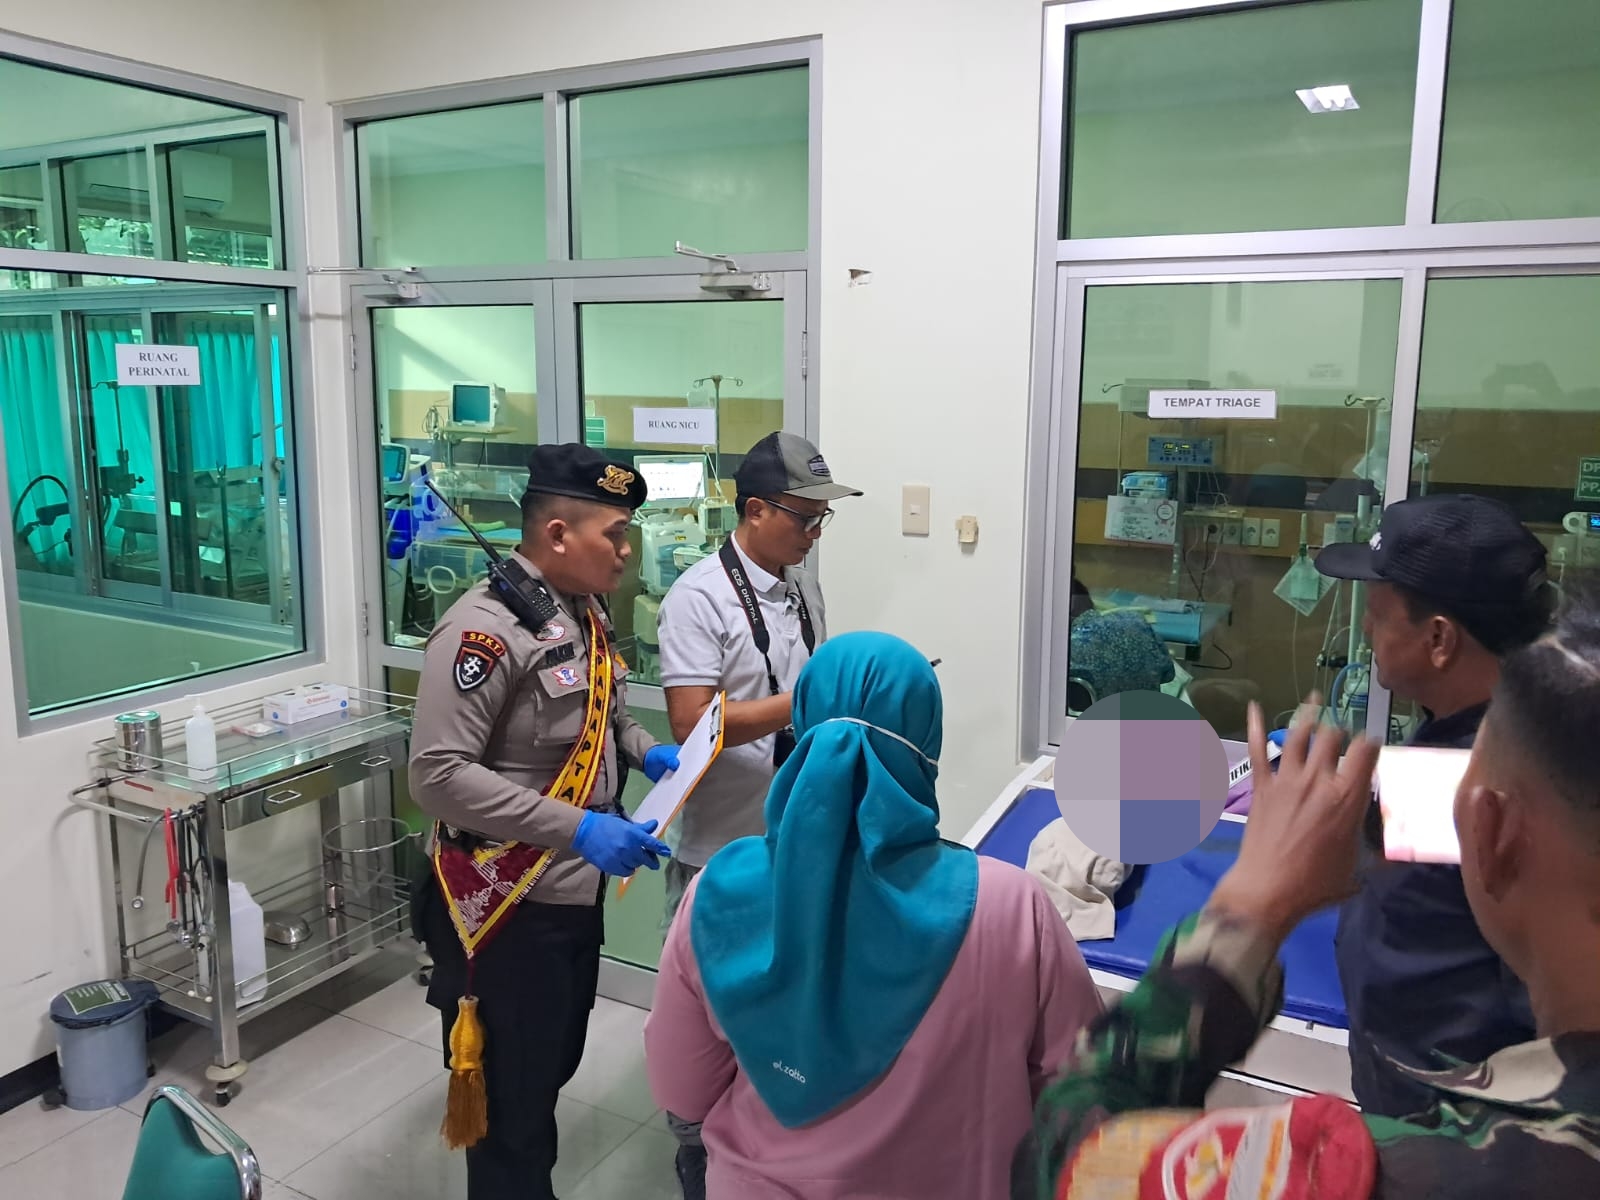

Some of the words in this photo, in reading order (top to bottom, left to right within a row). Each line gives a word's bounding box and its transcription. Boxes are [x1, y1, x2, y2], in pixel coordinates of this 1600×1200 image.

[139, 352, 178, 362] RUANG
[128, 366, 190, 377] PERINATAL
[1163, 397, 1212, 407] TEMPAT
[1215, 397, 1261, 408] TRIAGE
[648, 420, 677, 429] RUANG
[680, 421, 700, 430] NICU
[731, 568, 745, 587] EOS
[741, 588, 758, 625] DIGITAL
[469, 632, 501, 650] SPKT
